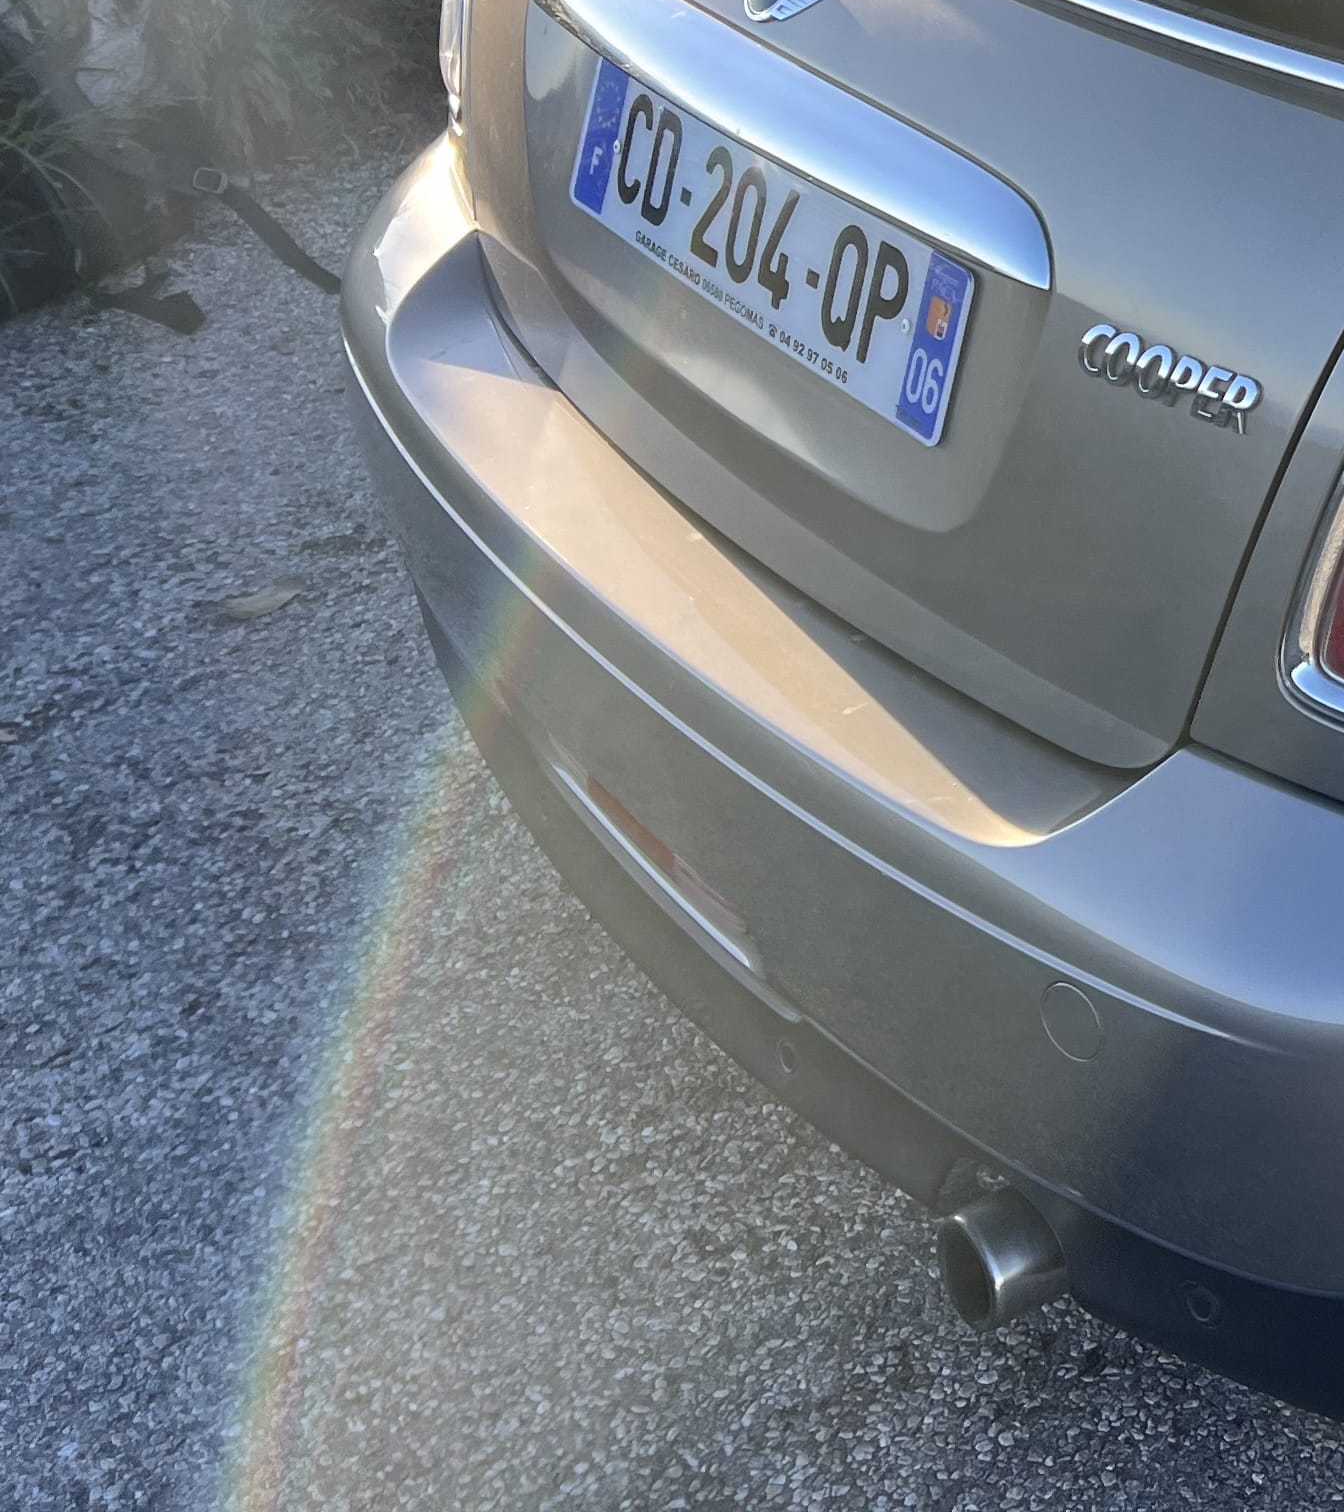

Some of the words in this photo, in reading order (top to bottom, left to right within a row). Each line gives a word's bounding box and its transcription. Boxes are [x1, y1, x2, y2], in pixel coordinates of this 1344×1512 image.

[589, 146, 604, 176] F
[617, 93, 910, 364] CD-204-QP
[635, 230, 667, 262] GARAGE
[668, 254, 700, 285] CESARO
[724, 293, 763, 330] PEGOMAS
[780, 330, 791, 348] 04
[793, 339, 806, 357] 92
[806, 348, 820, 365] 97
[820, 357, 834, 375] 05
[835, 368, 848, 384] 06
[905, 347, 944, 415] 06
[1079, 323, 1264, 435] COOPER
